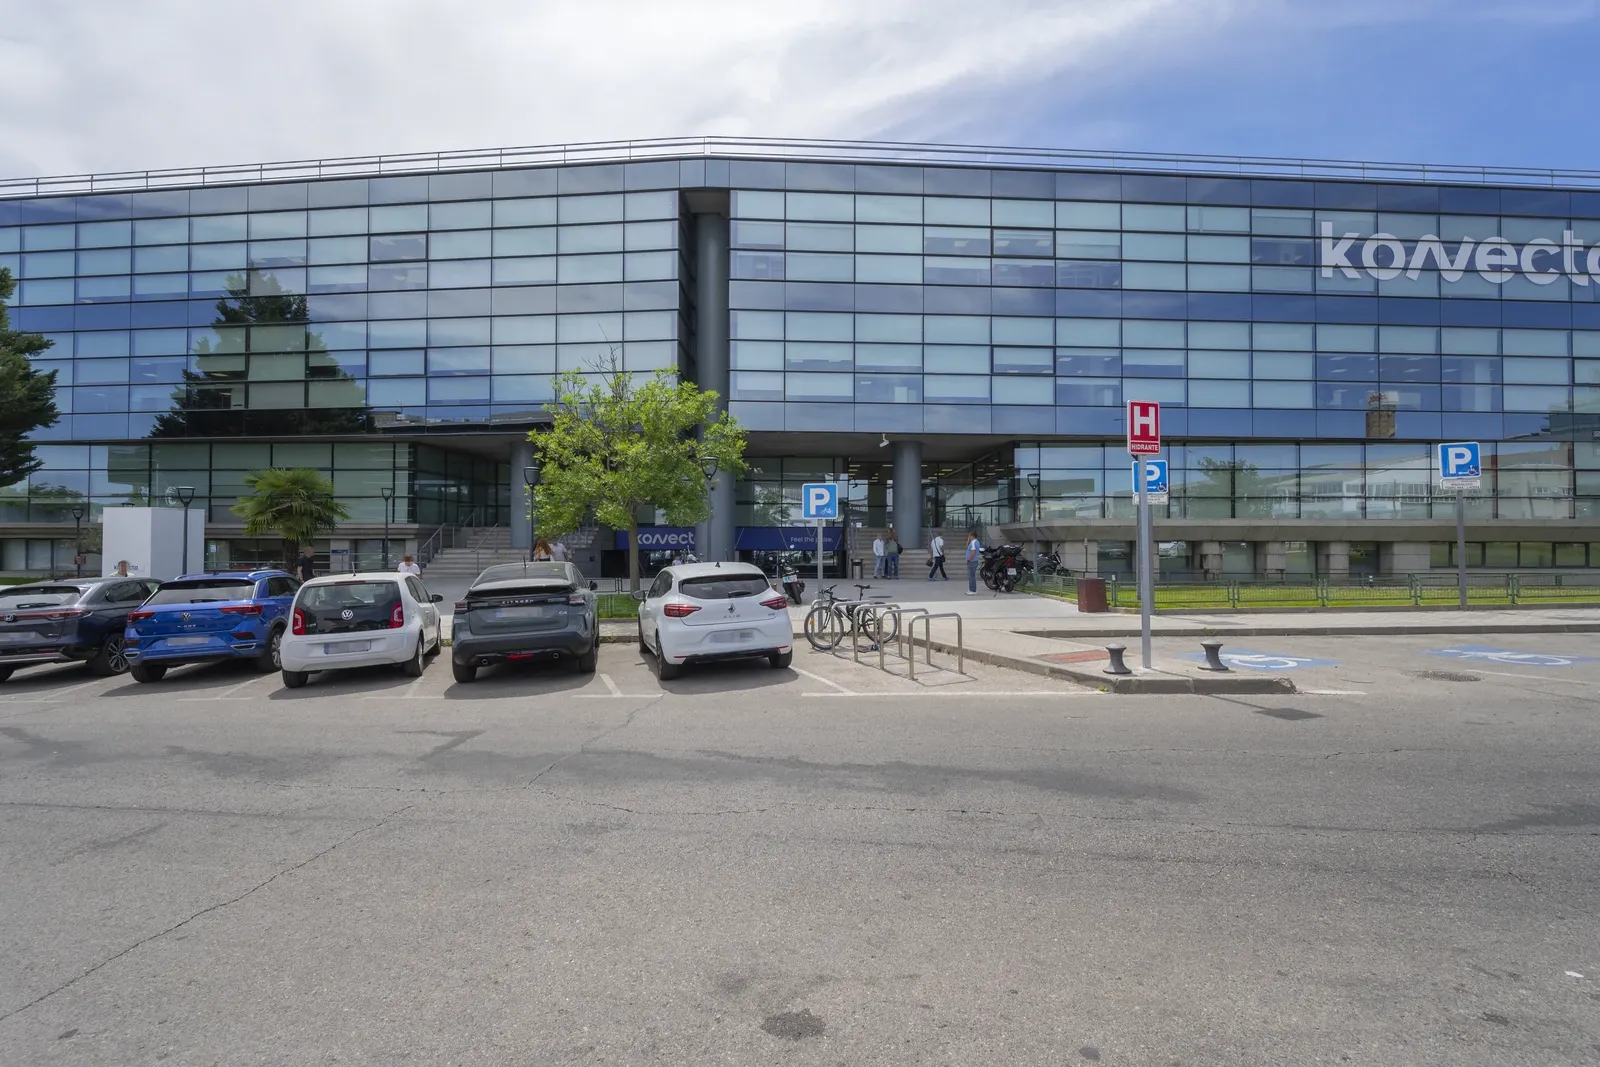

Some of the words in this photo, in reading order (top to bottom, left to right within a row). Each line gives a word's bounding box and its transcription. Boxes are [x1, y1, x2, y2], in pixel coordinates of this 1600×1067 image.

[1320, 221, 1600, 286] konect
[1133, 406, 1155, 436] H
[1448, 447, 1472, 474] P
[810, 488, 830, 514] P
